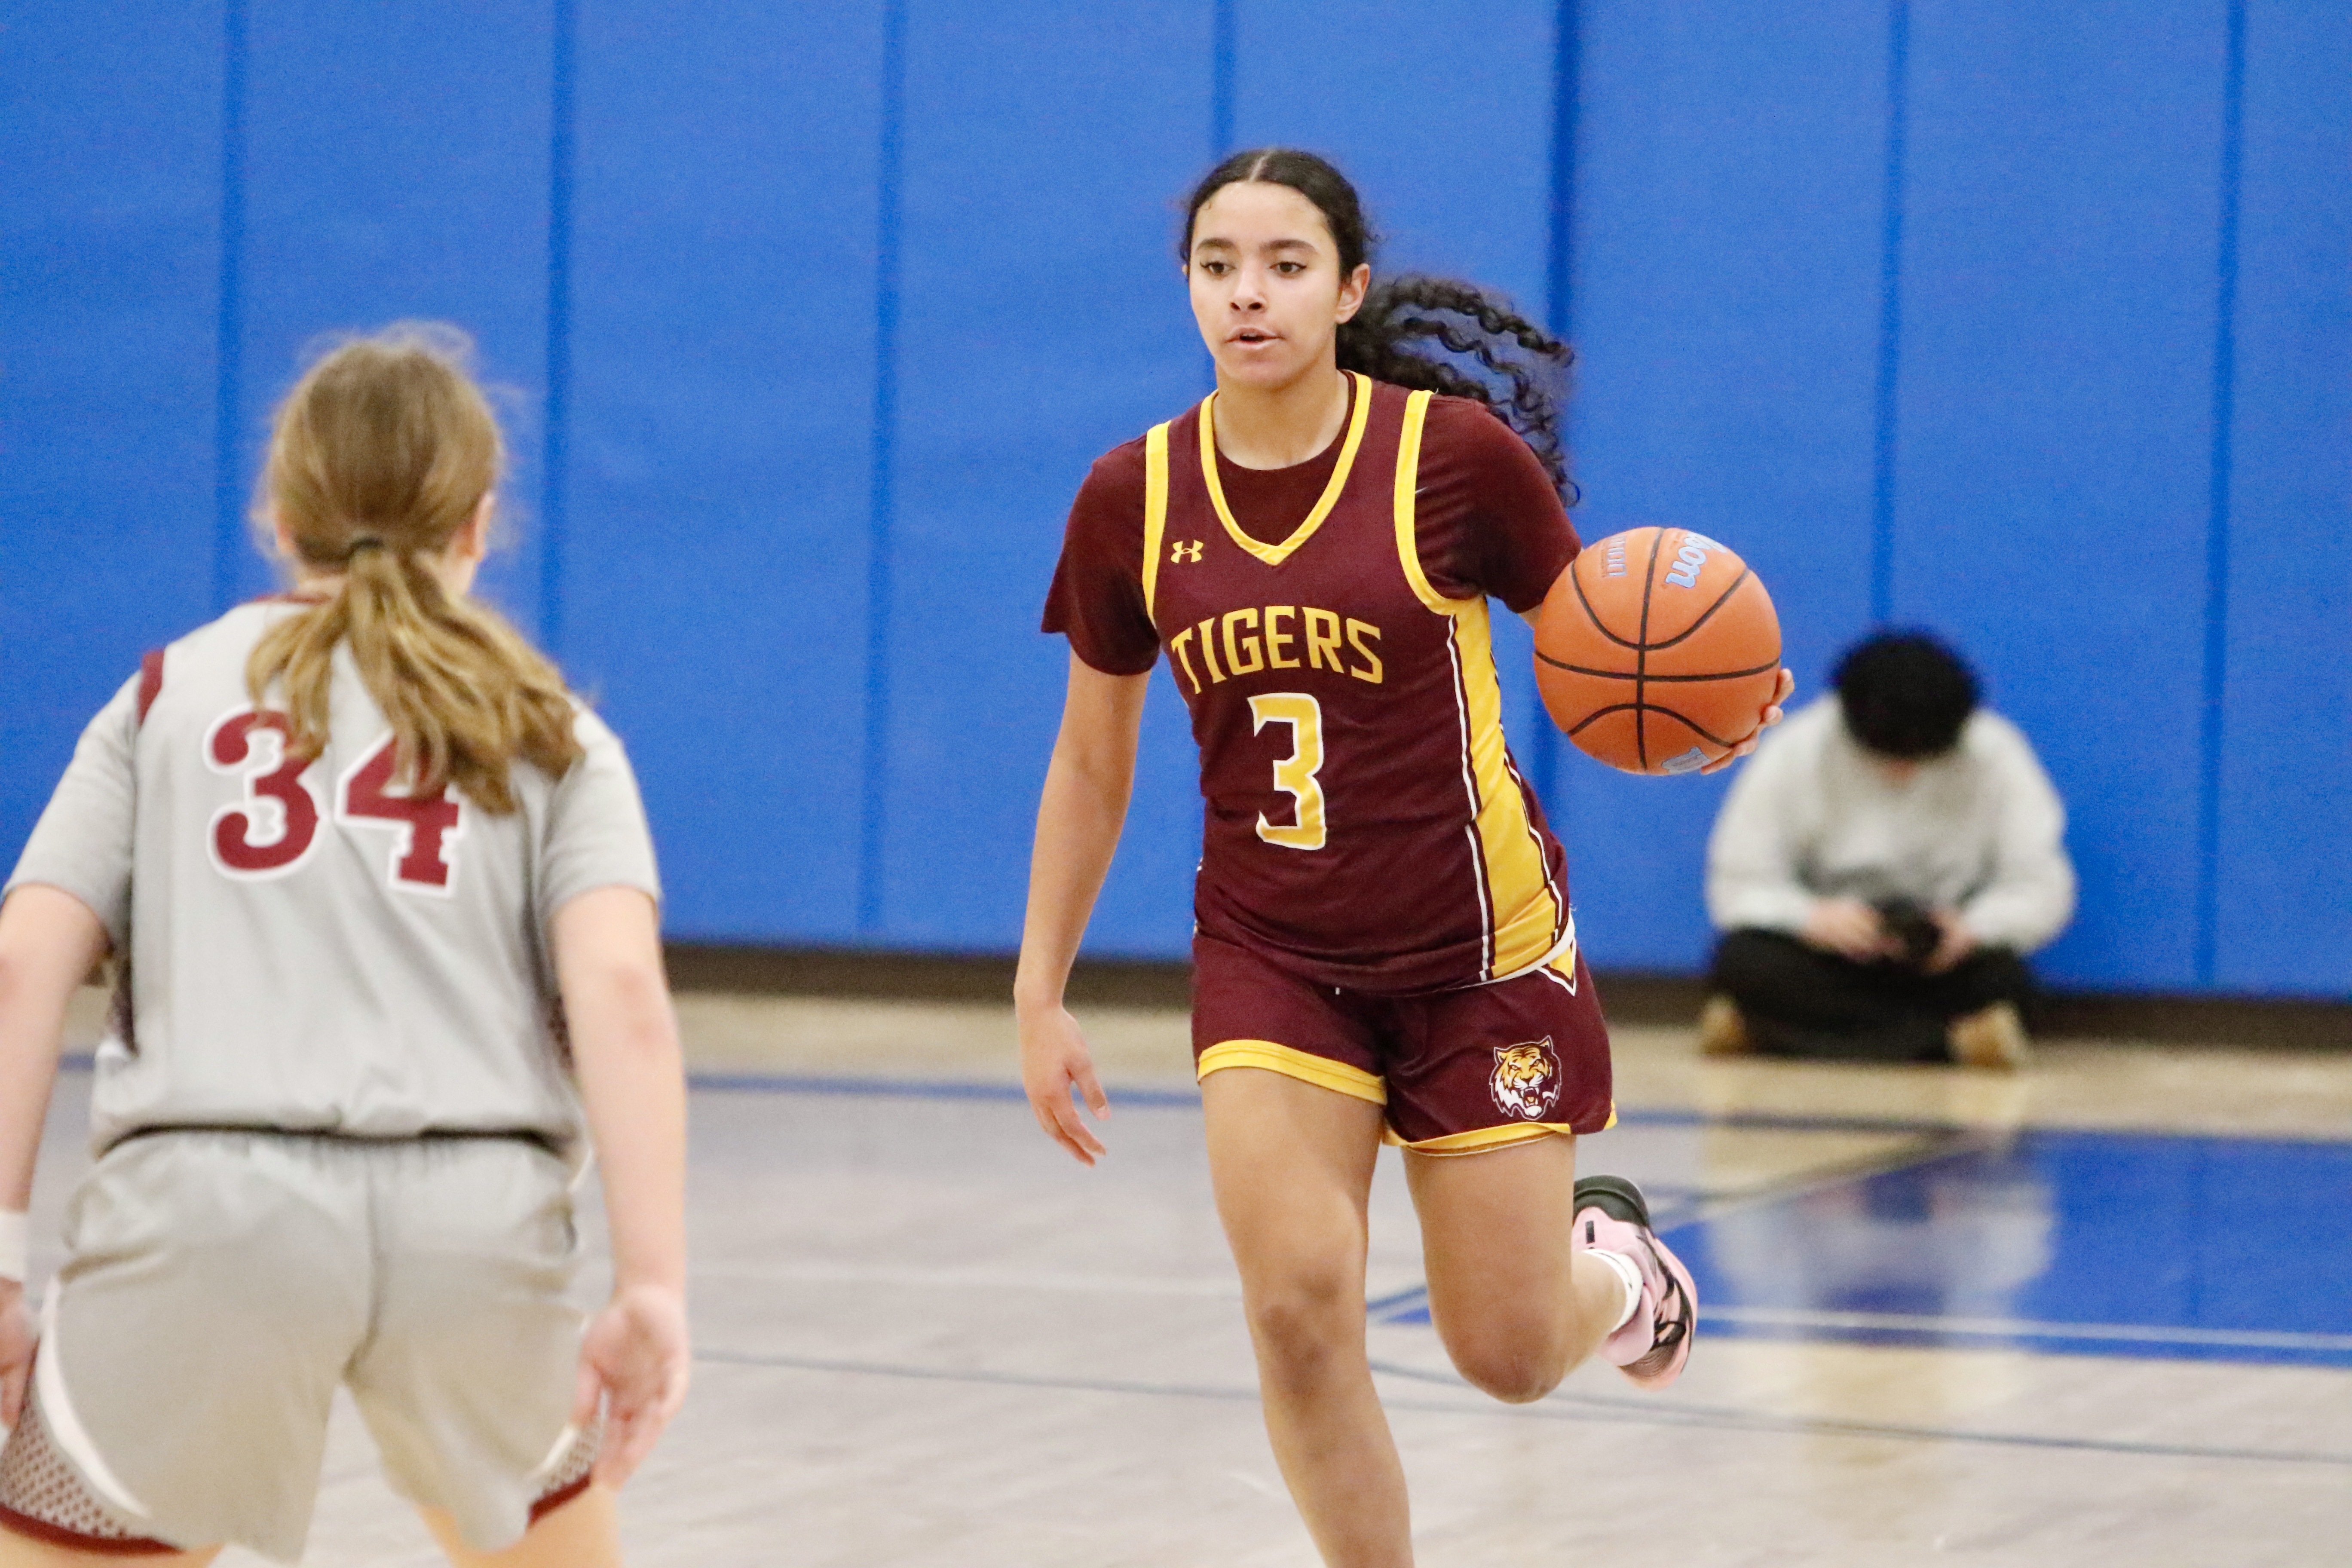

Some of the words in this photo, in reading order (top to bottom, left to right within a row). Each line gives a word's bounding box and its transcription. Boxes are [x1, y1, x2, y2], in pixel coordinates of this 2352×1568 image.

[1170, 606, 1383, 694] TIGERS
[203, 703, 464, 898] 34
[1247, 692, 1327, 850] 3
